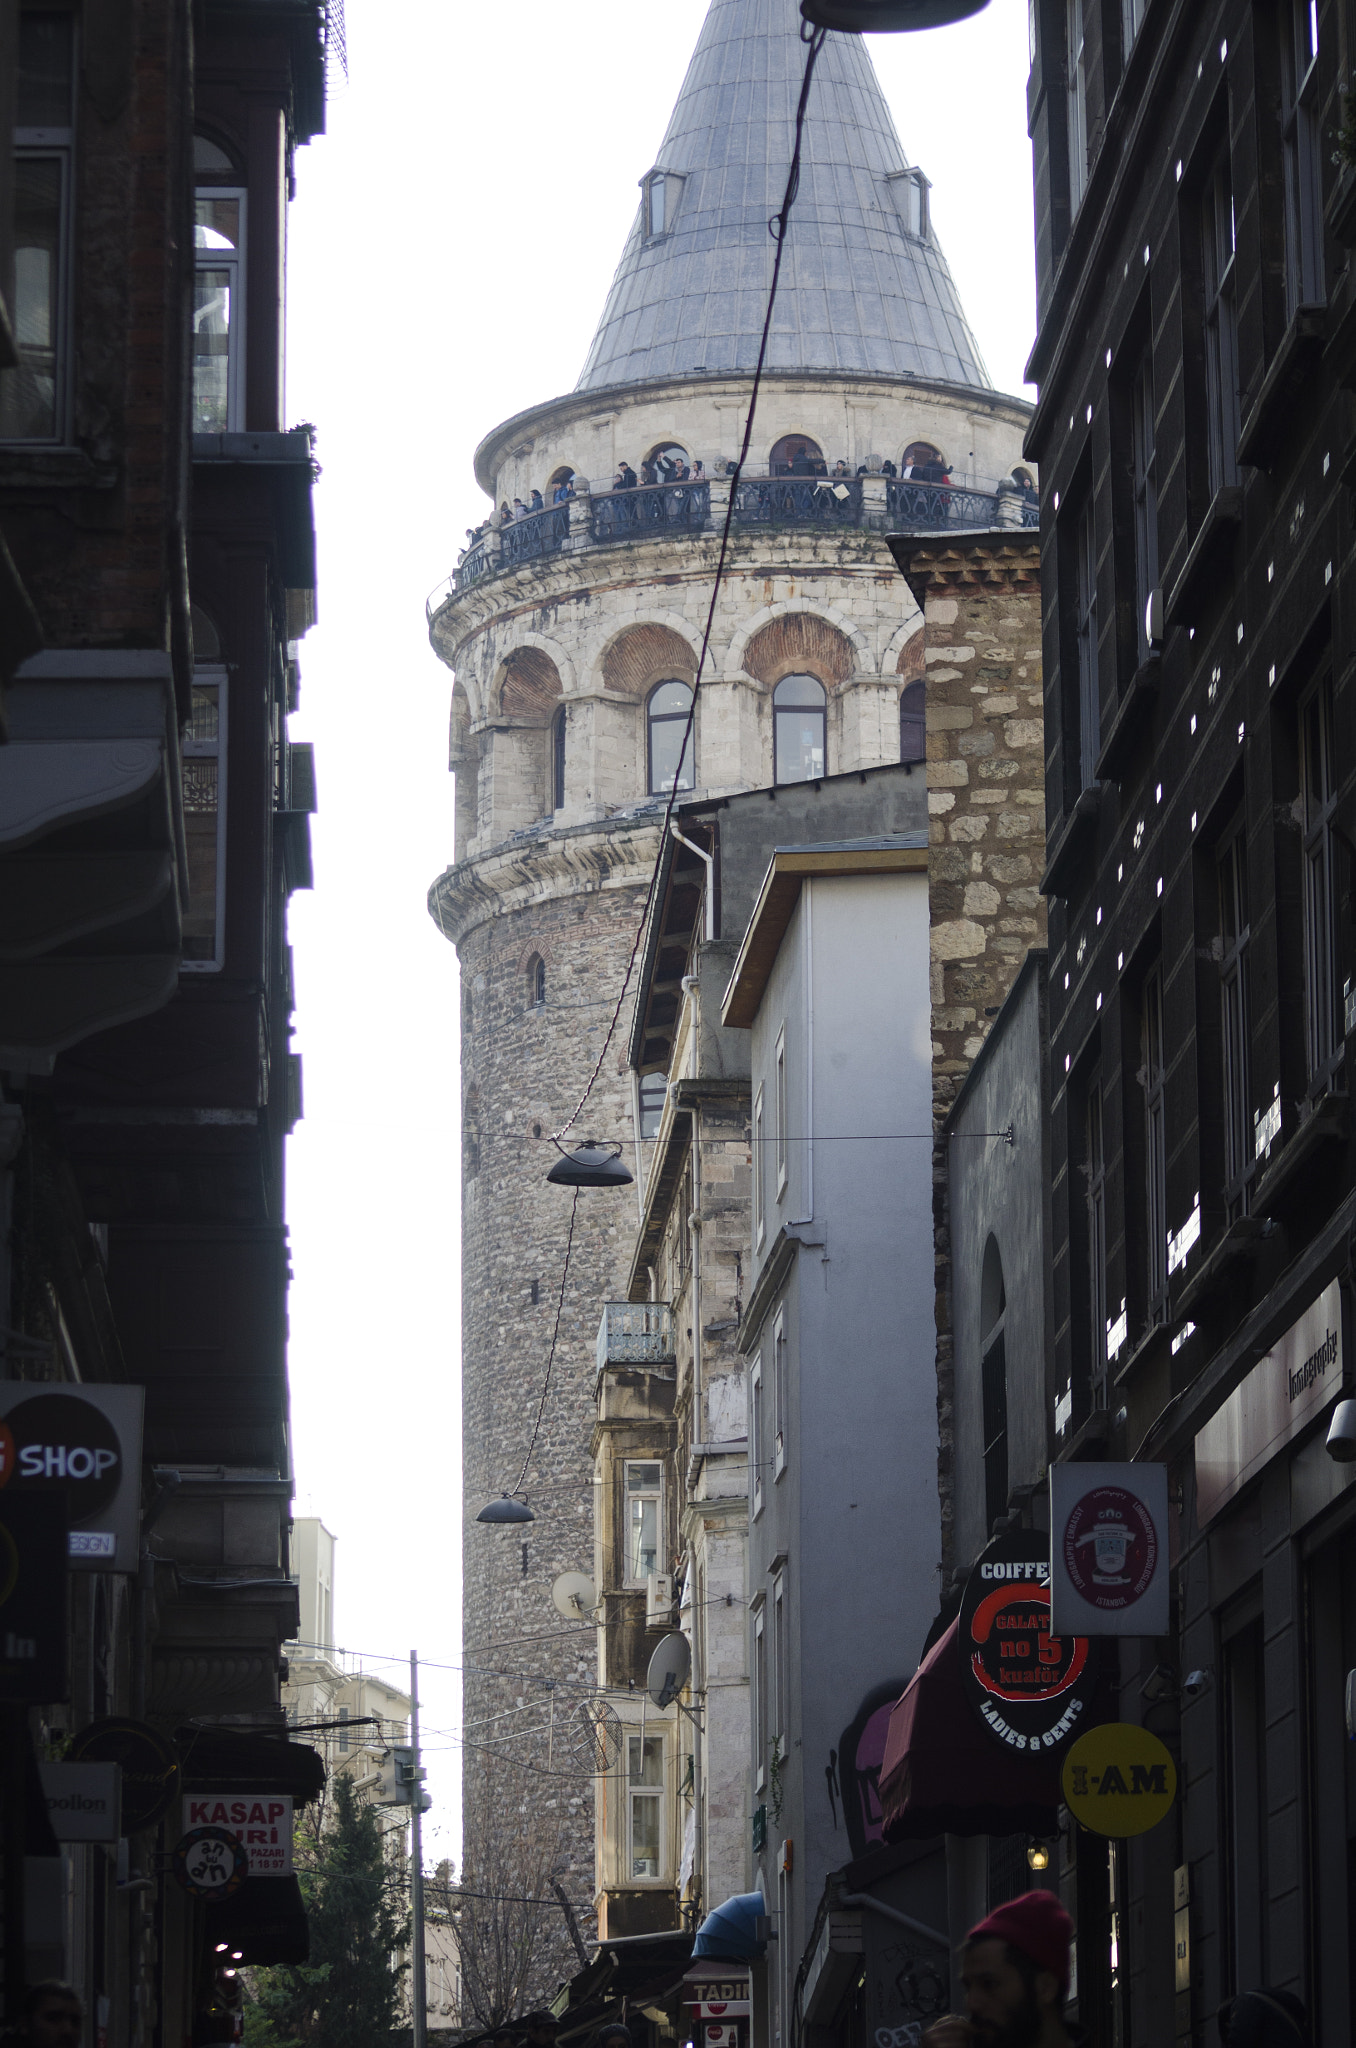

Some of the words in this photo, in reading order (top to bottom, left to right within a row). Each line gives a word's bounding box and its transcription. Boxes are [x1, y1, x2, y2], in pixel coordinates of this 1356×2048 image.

[1289, 1328, 1337, 1403] lomography
[18, 1444, 118, 1480] SHOP
[1066, 1506, 1084, 1539] EMBASSY
[1132, 1501, 1155, 1544] LOMOGRAPHY
[980, 1562, 1050, 1579] COIFFE
[1065, 1541, 1086, 1590] LOMOGRAPHY
[1000, 1640, 1031, 1658] no
[1037, 1631, 1063, 1665] 5
[1000, 1666, 1060, 1684] kuaför
[979, 1700, 1028, 1750] LADIES
[1029, 1736, 1041, 1750] &
[1041, 1698, 1084, 1748] GENTS
[1071, 1764, 1168, 1796] I-AM
[190, 1802, 285, 1824] KASAP
[201, 1842, 225, 1857] an
[206, 1854, 218, 1864] bu
[251, 1848, 285, 1857] PAZARI
[191, 1861, 227, 1882] an
[258, 1860, 270, 1869] 18
[272, 1860, 285, 1869] 97
